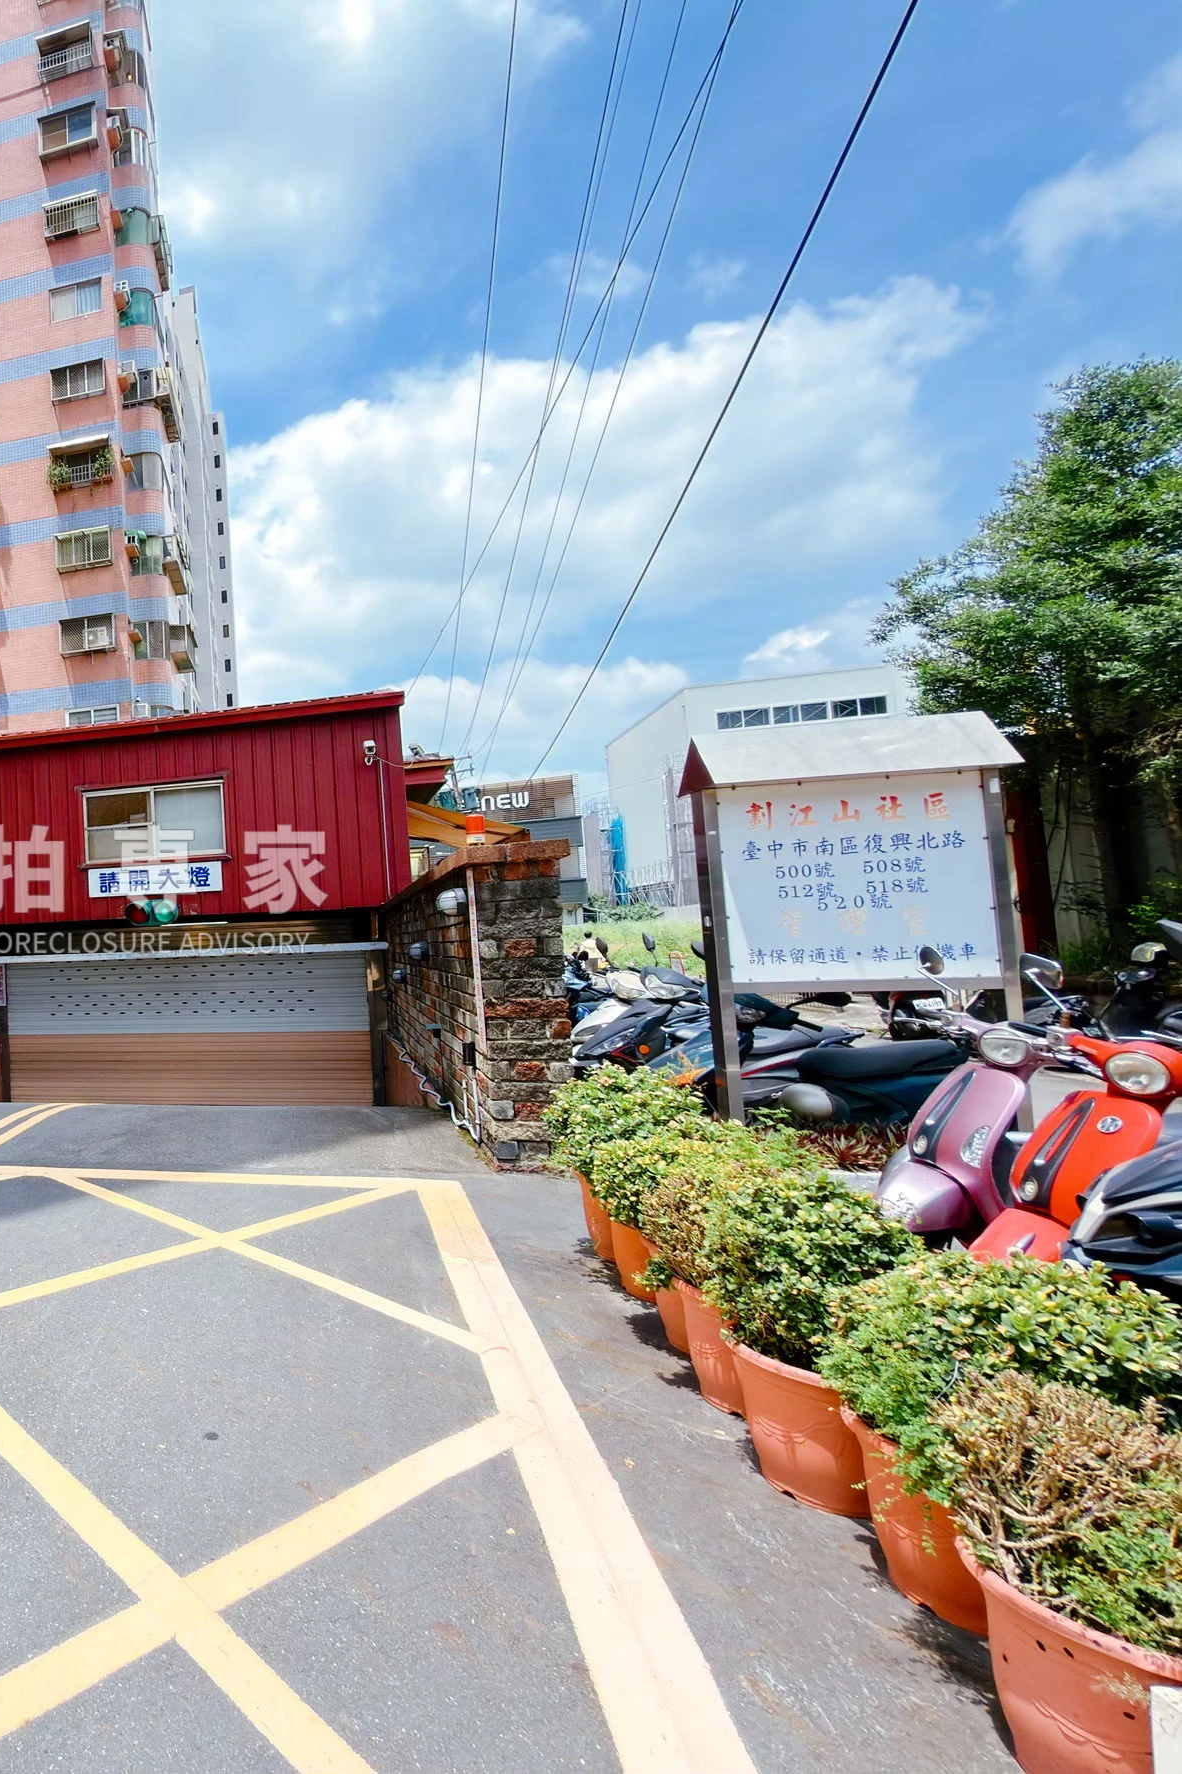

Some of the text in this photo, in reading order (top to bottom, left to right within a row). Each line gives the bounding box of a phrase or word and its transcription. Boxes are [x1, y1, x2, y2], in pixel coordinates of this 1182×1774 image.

[742, 830, 966, 861] 臺中市南區復興北路
[99, 866, 210, 893] 請開大燈
[775, 856, 926, 879] 500號 508號
[778, 877, 928, 899] 512號 518號
